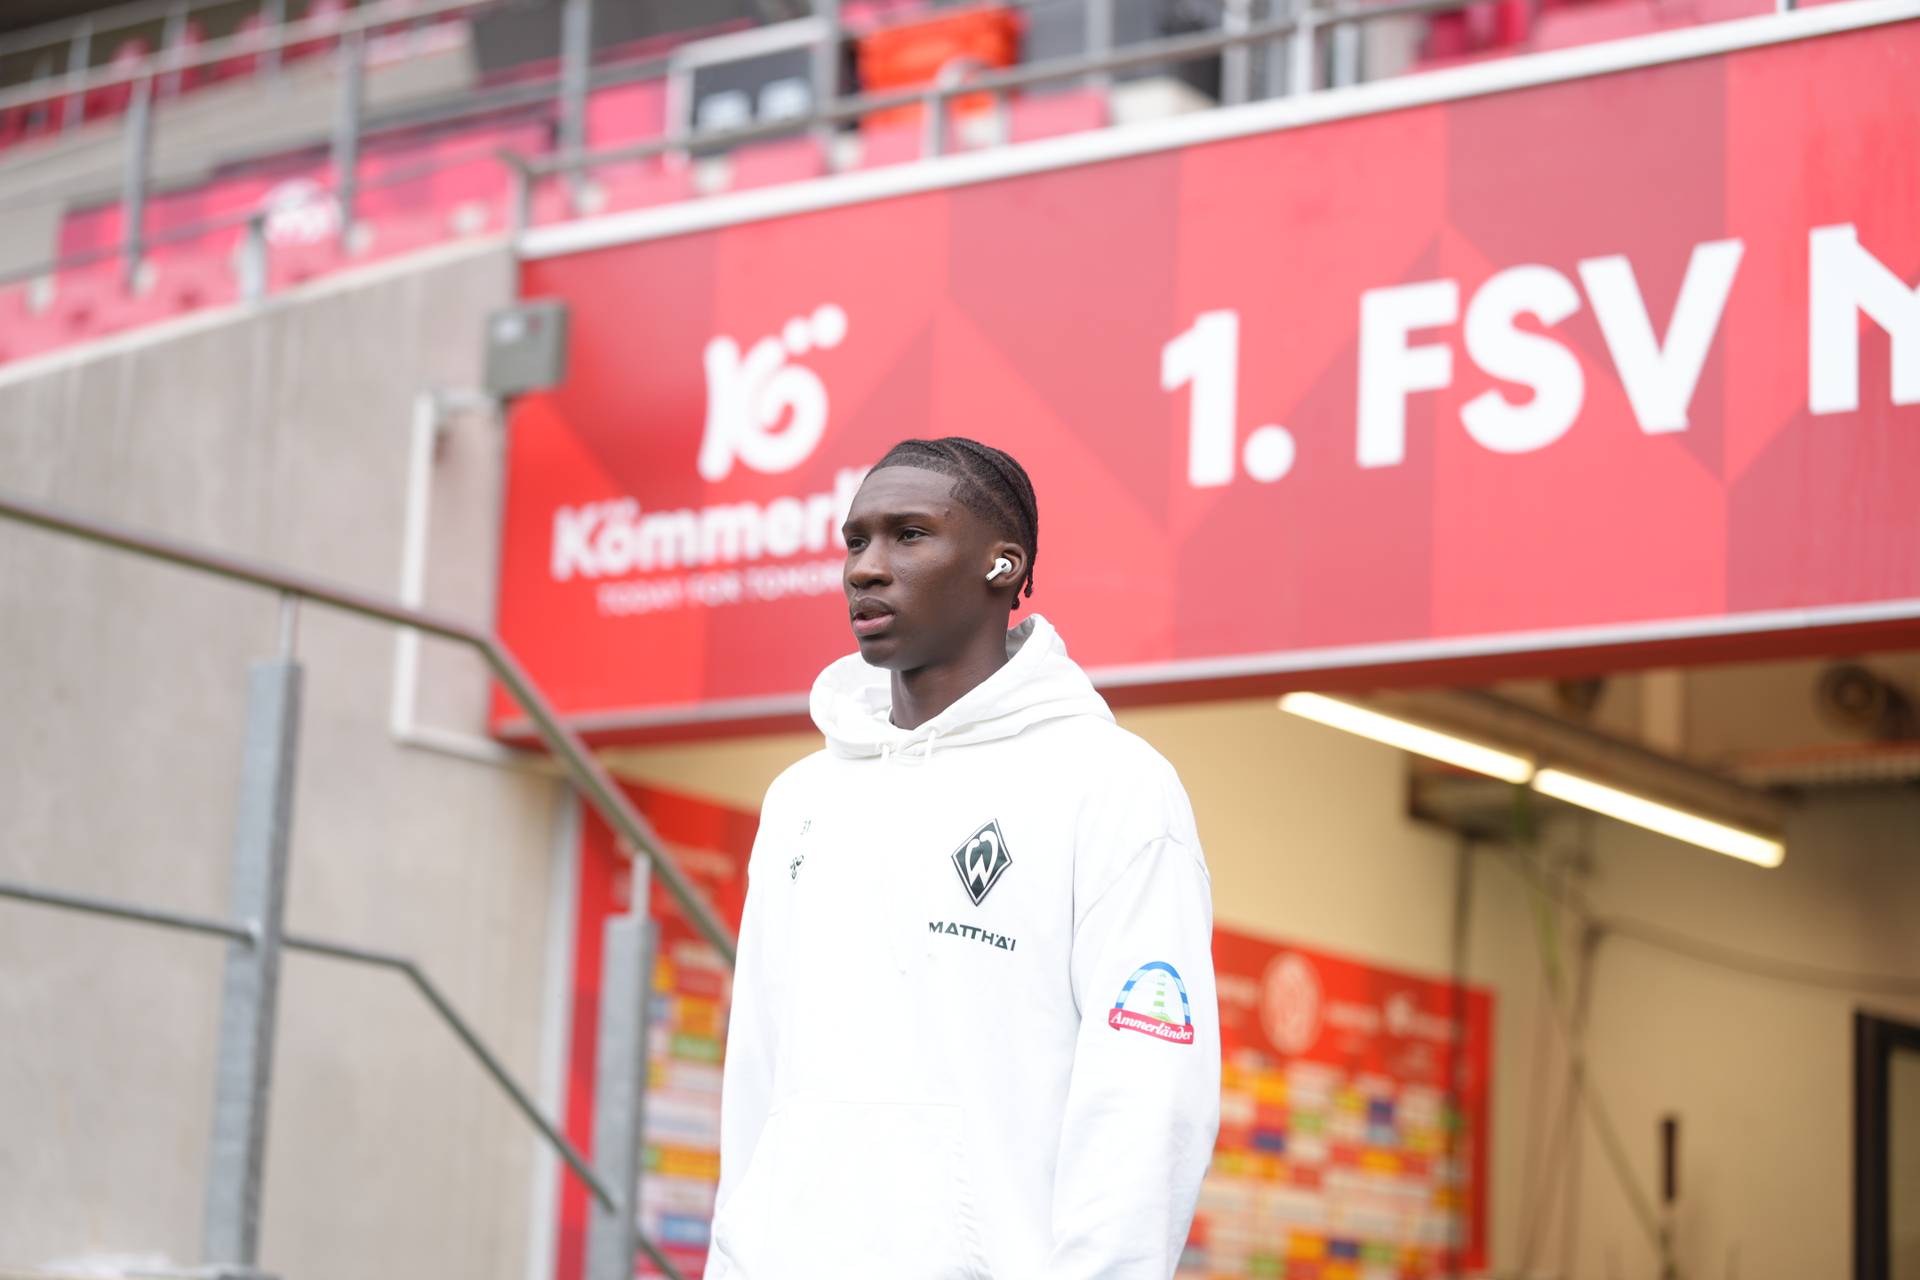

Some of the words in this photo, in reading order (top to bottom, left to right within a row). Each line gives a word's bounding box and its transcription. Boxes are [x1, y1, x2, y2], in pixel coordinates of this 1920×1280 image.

[1160, 309, 1295, 487] 1.
[1356, 238, 1745, 468] FSV
[929, 921, 1016, 951] MATTHÄI
[1110, 1011, 1192, 1040] Ammerländer
